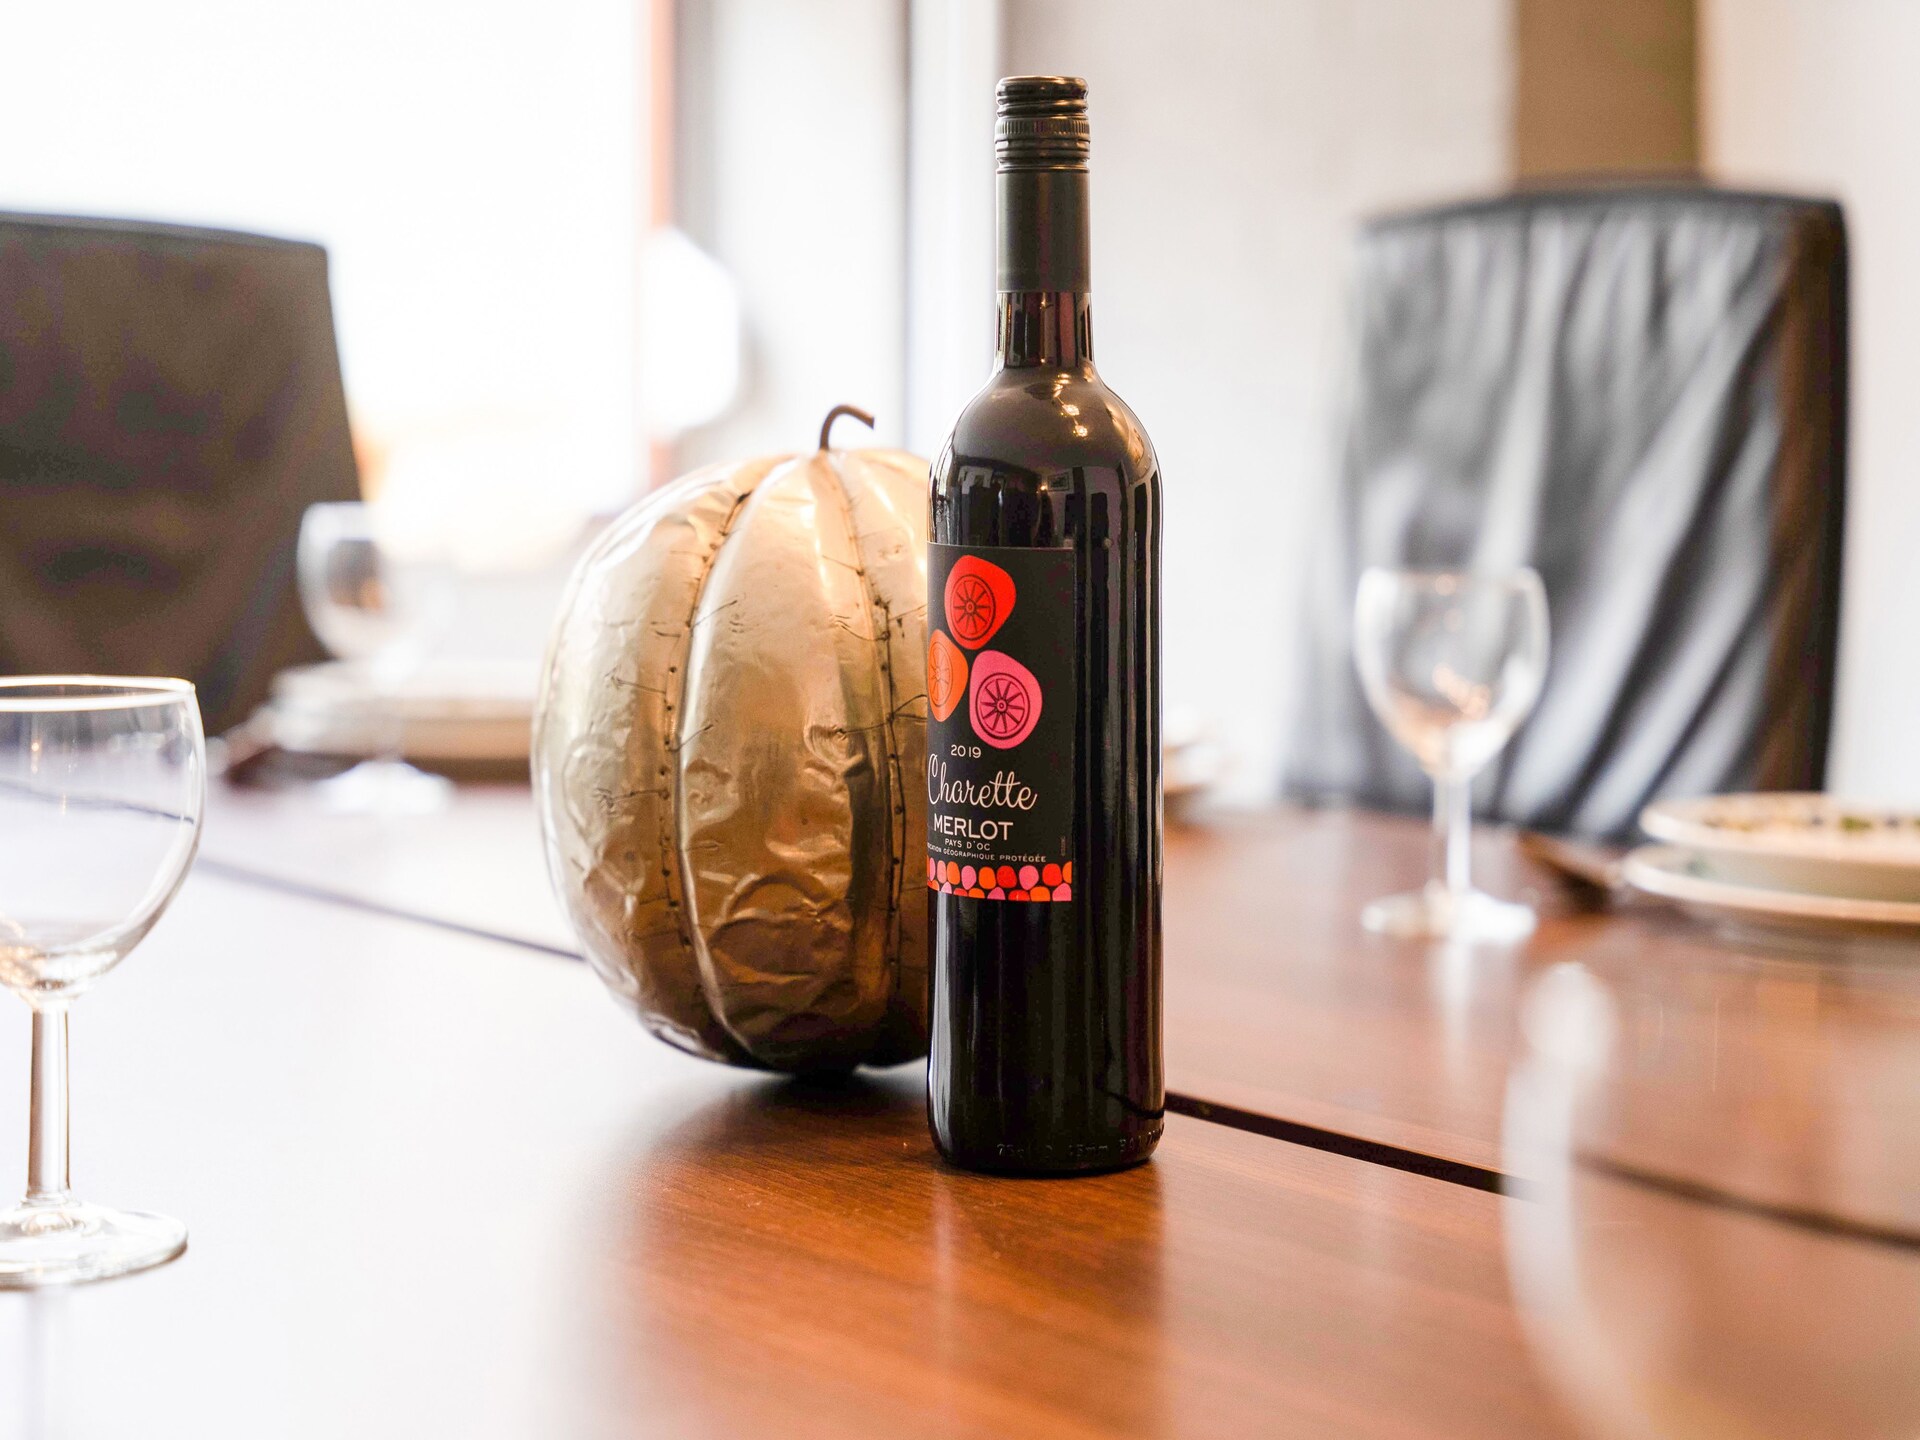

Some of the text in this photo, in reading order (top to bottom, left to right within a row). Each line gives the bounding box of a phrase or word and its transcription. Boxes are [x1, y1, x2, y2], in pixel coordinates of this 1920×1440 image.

[950, 744, 981, 758] 2019
[928, 753, 1037, 810] Charette
[934, 813, 1013, 840] MERLOT
[945, 838, 962, 848] PAYS
[943, 847, 995, 860] GÉOGRAPHIQUE
[1000, 853, 1047, 863] PROTÉGÉE
